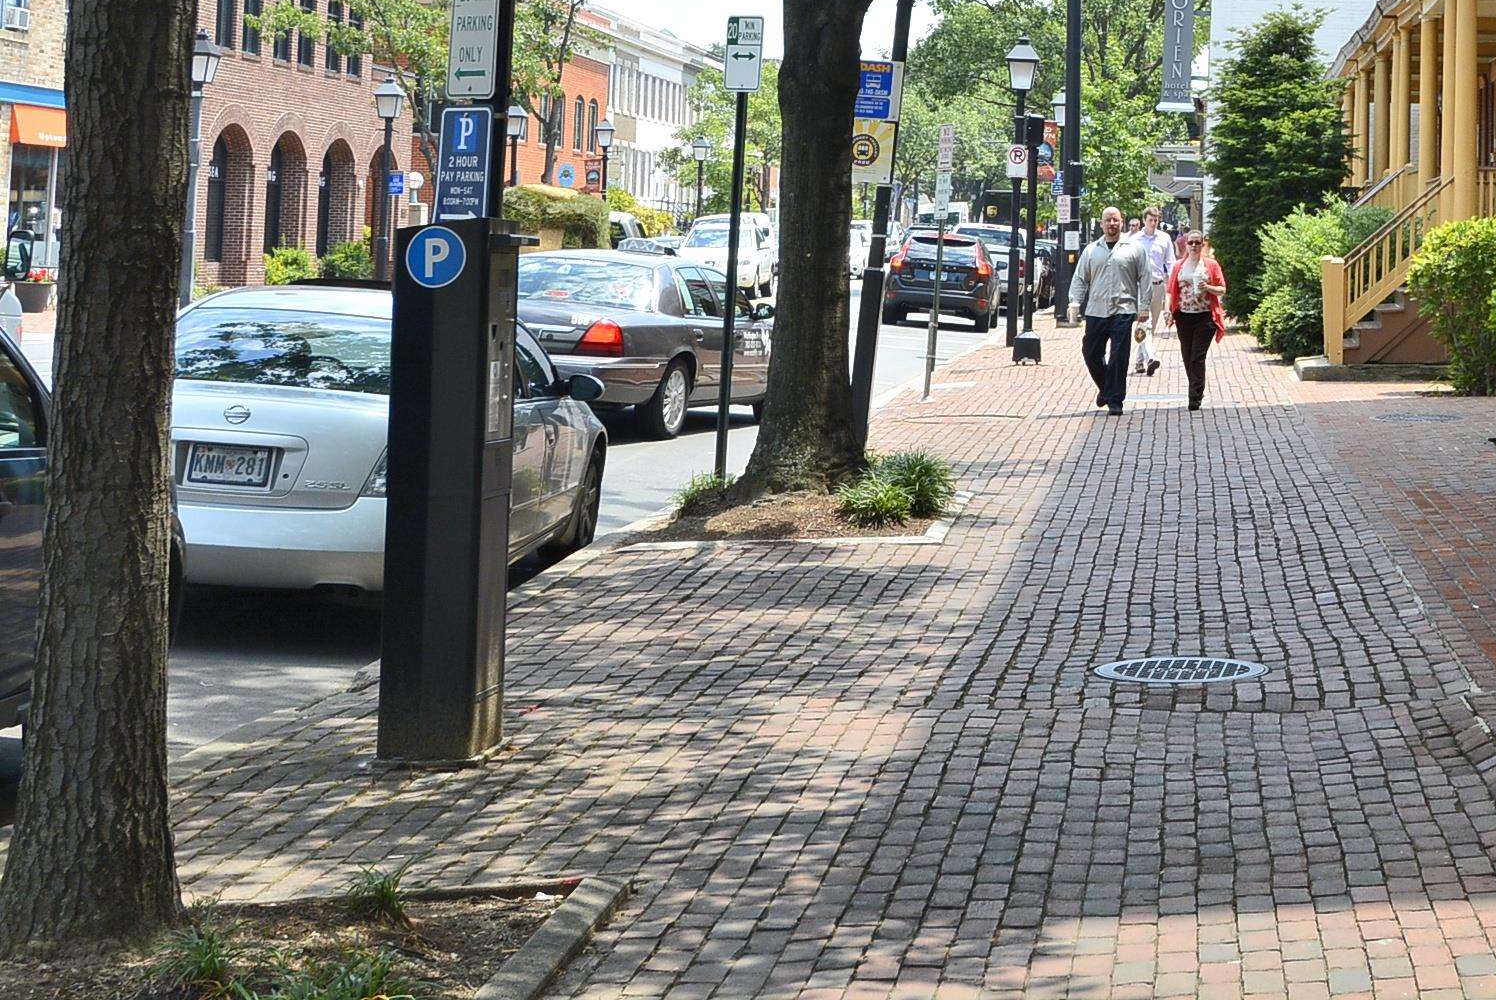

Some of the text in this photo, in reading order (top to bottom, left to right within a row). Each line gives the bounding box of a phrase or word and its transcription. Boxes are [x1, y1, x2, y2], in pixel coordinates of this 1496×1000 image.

[456, 14, 493, 32] PARKING
[727, 22, 738, 39] 20
[738, 31, 761, 41] PARKING
[459, 46, 482, 63] ONLY
[860, 62, 891, 73] DASH
[1164, 80, 1189, 89] hotel
[457, 117, 474, 150] P
[448, 155, 479, 168] 2 HOUR
[440, 171, 485, 182] PAY PARKING
[424, 238, 450, 278] P
[235, 456, 265, 477] 281
